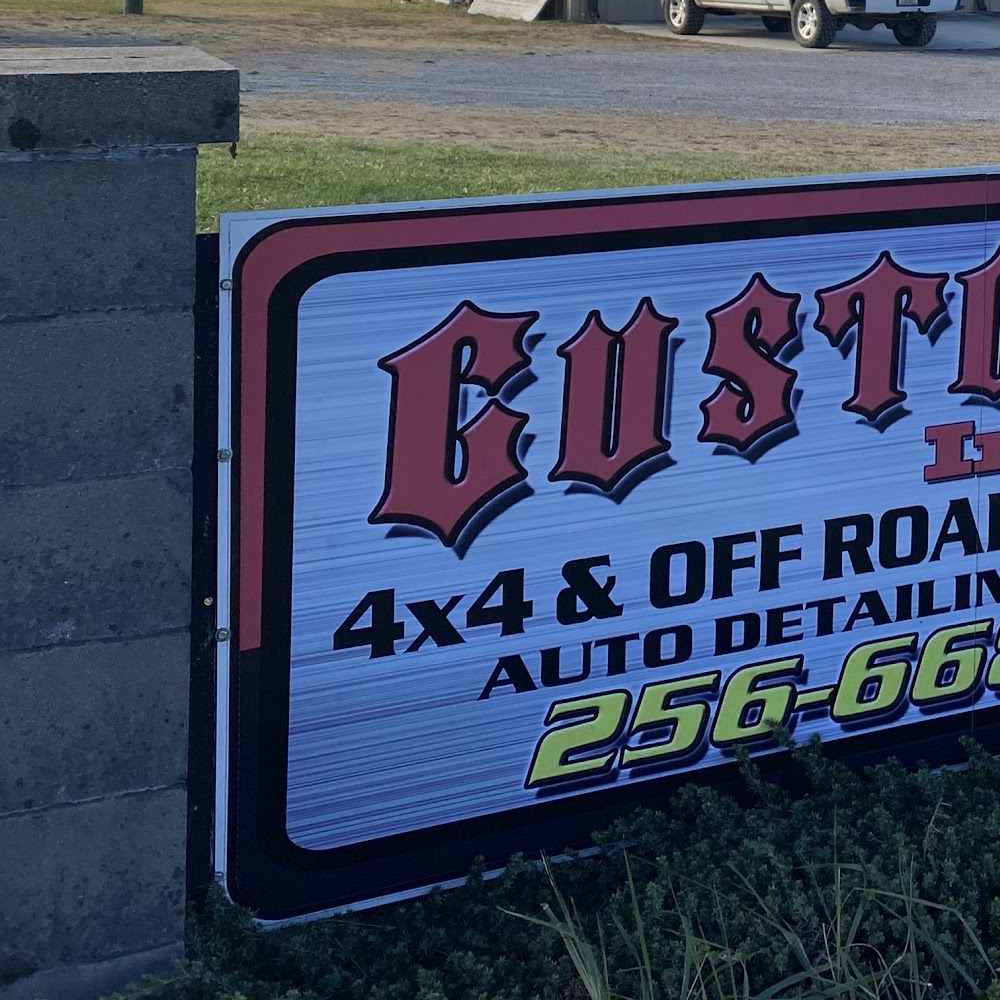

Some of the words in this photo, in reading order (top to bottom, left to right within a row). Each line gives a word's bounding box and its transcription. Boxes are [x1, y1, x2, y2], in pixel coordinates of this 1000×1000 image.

[333, 568, 533, 659] 4x4
[556, 555, 624, 627] &
[649, 524, 803, 608] OFF
[477, 625, 694, 701] AUTO
